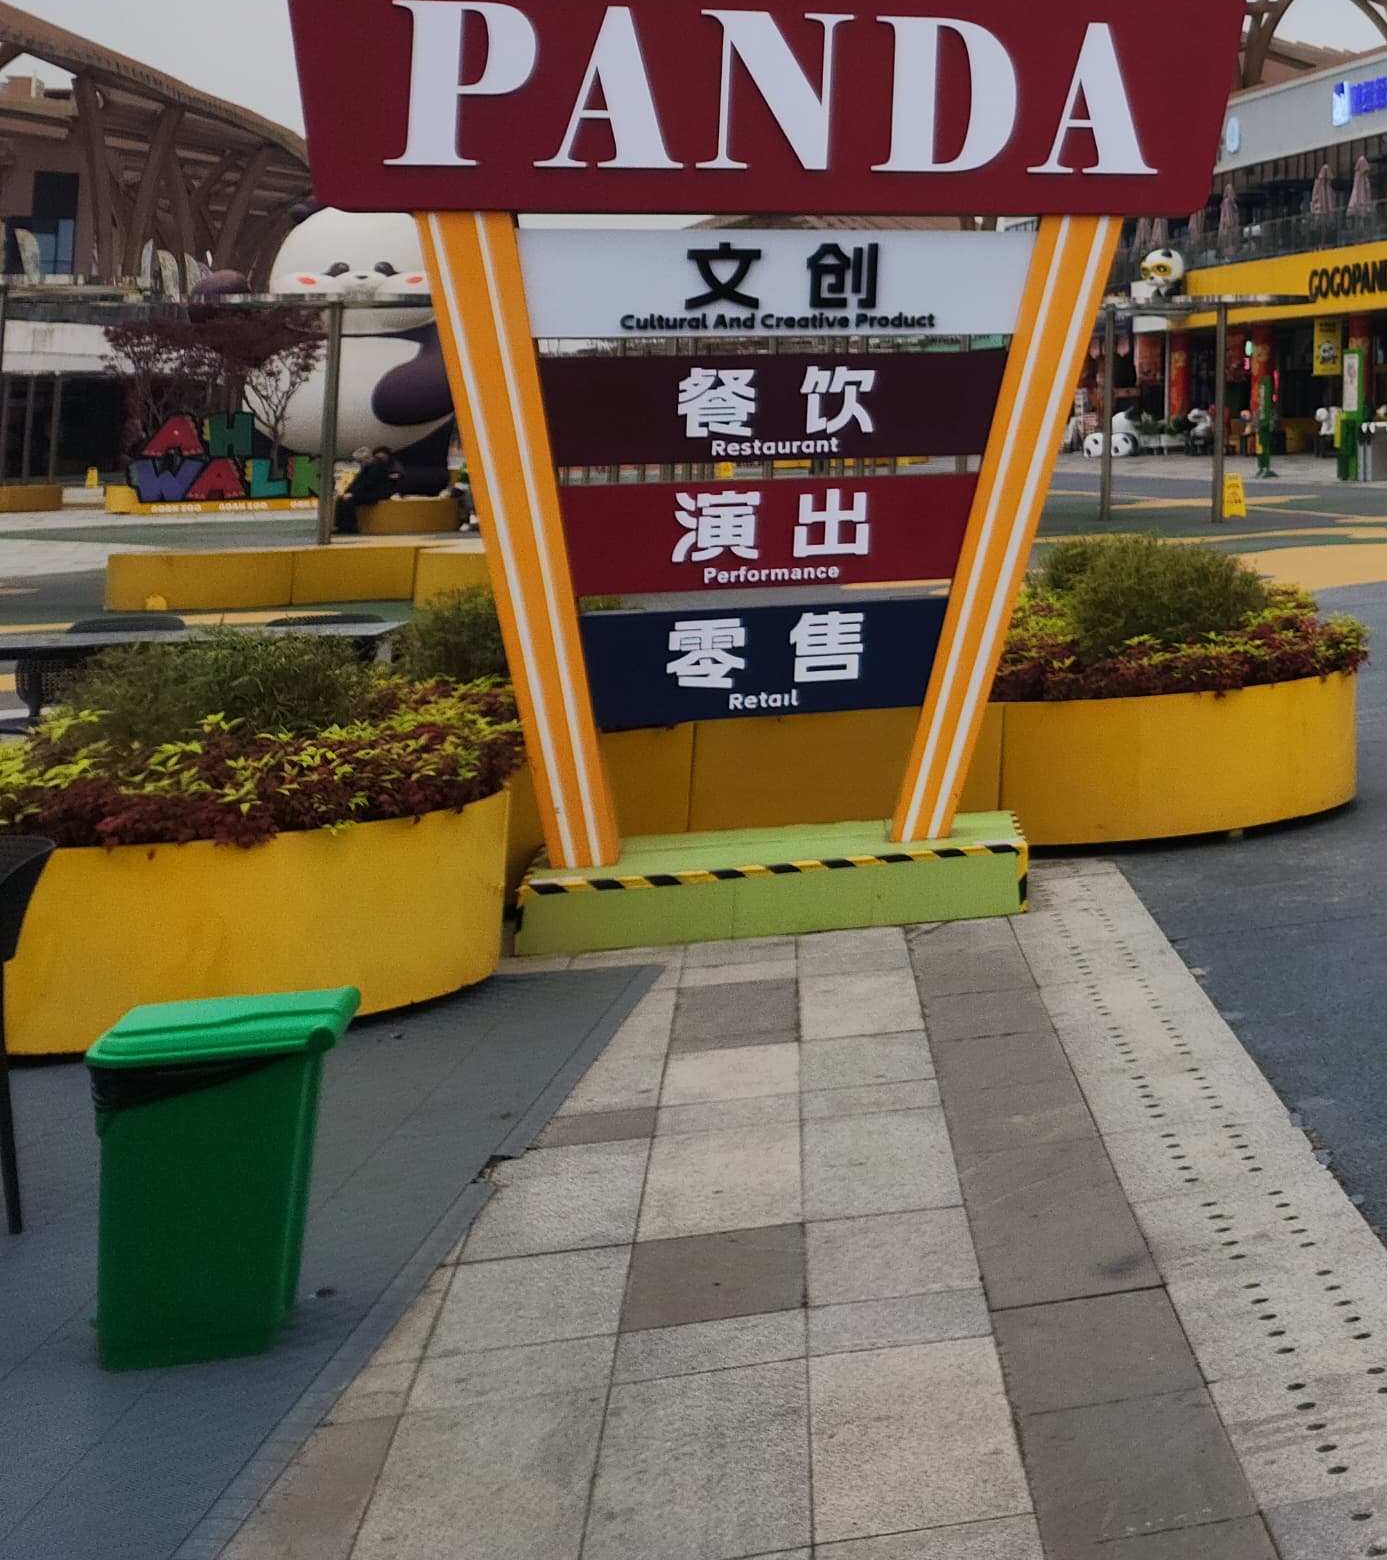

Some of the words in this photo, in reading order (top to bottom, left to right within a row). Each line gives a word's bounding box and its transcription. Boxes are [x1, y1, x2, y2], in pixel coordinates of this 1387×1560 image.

[685, 242, 880, 310] 文创
[620, 313, 708, 331] Cultural
[713, 313, 756, 330] And
[761, 313, 851, 330] Creative
[855, 312, 936, 330] Product
[677, 365, 876, 437] 餐饮
[711, 437, 839, 456] Restaurant
[671, 488, 870, 563] 演出
[703, 564, 840, 584] Performance
[666, 610, 864, 690] 零售
[728, 689, 799, 711] Retail
